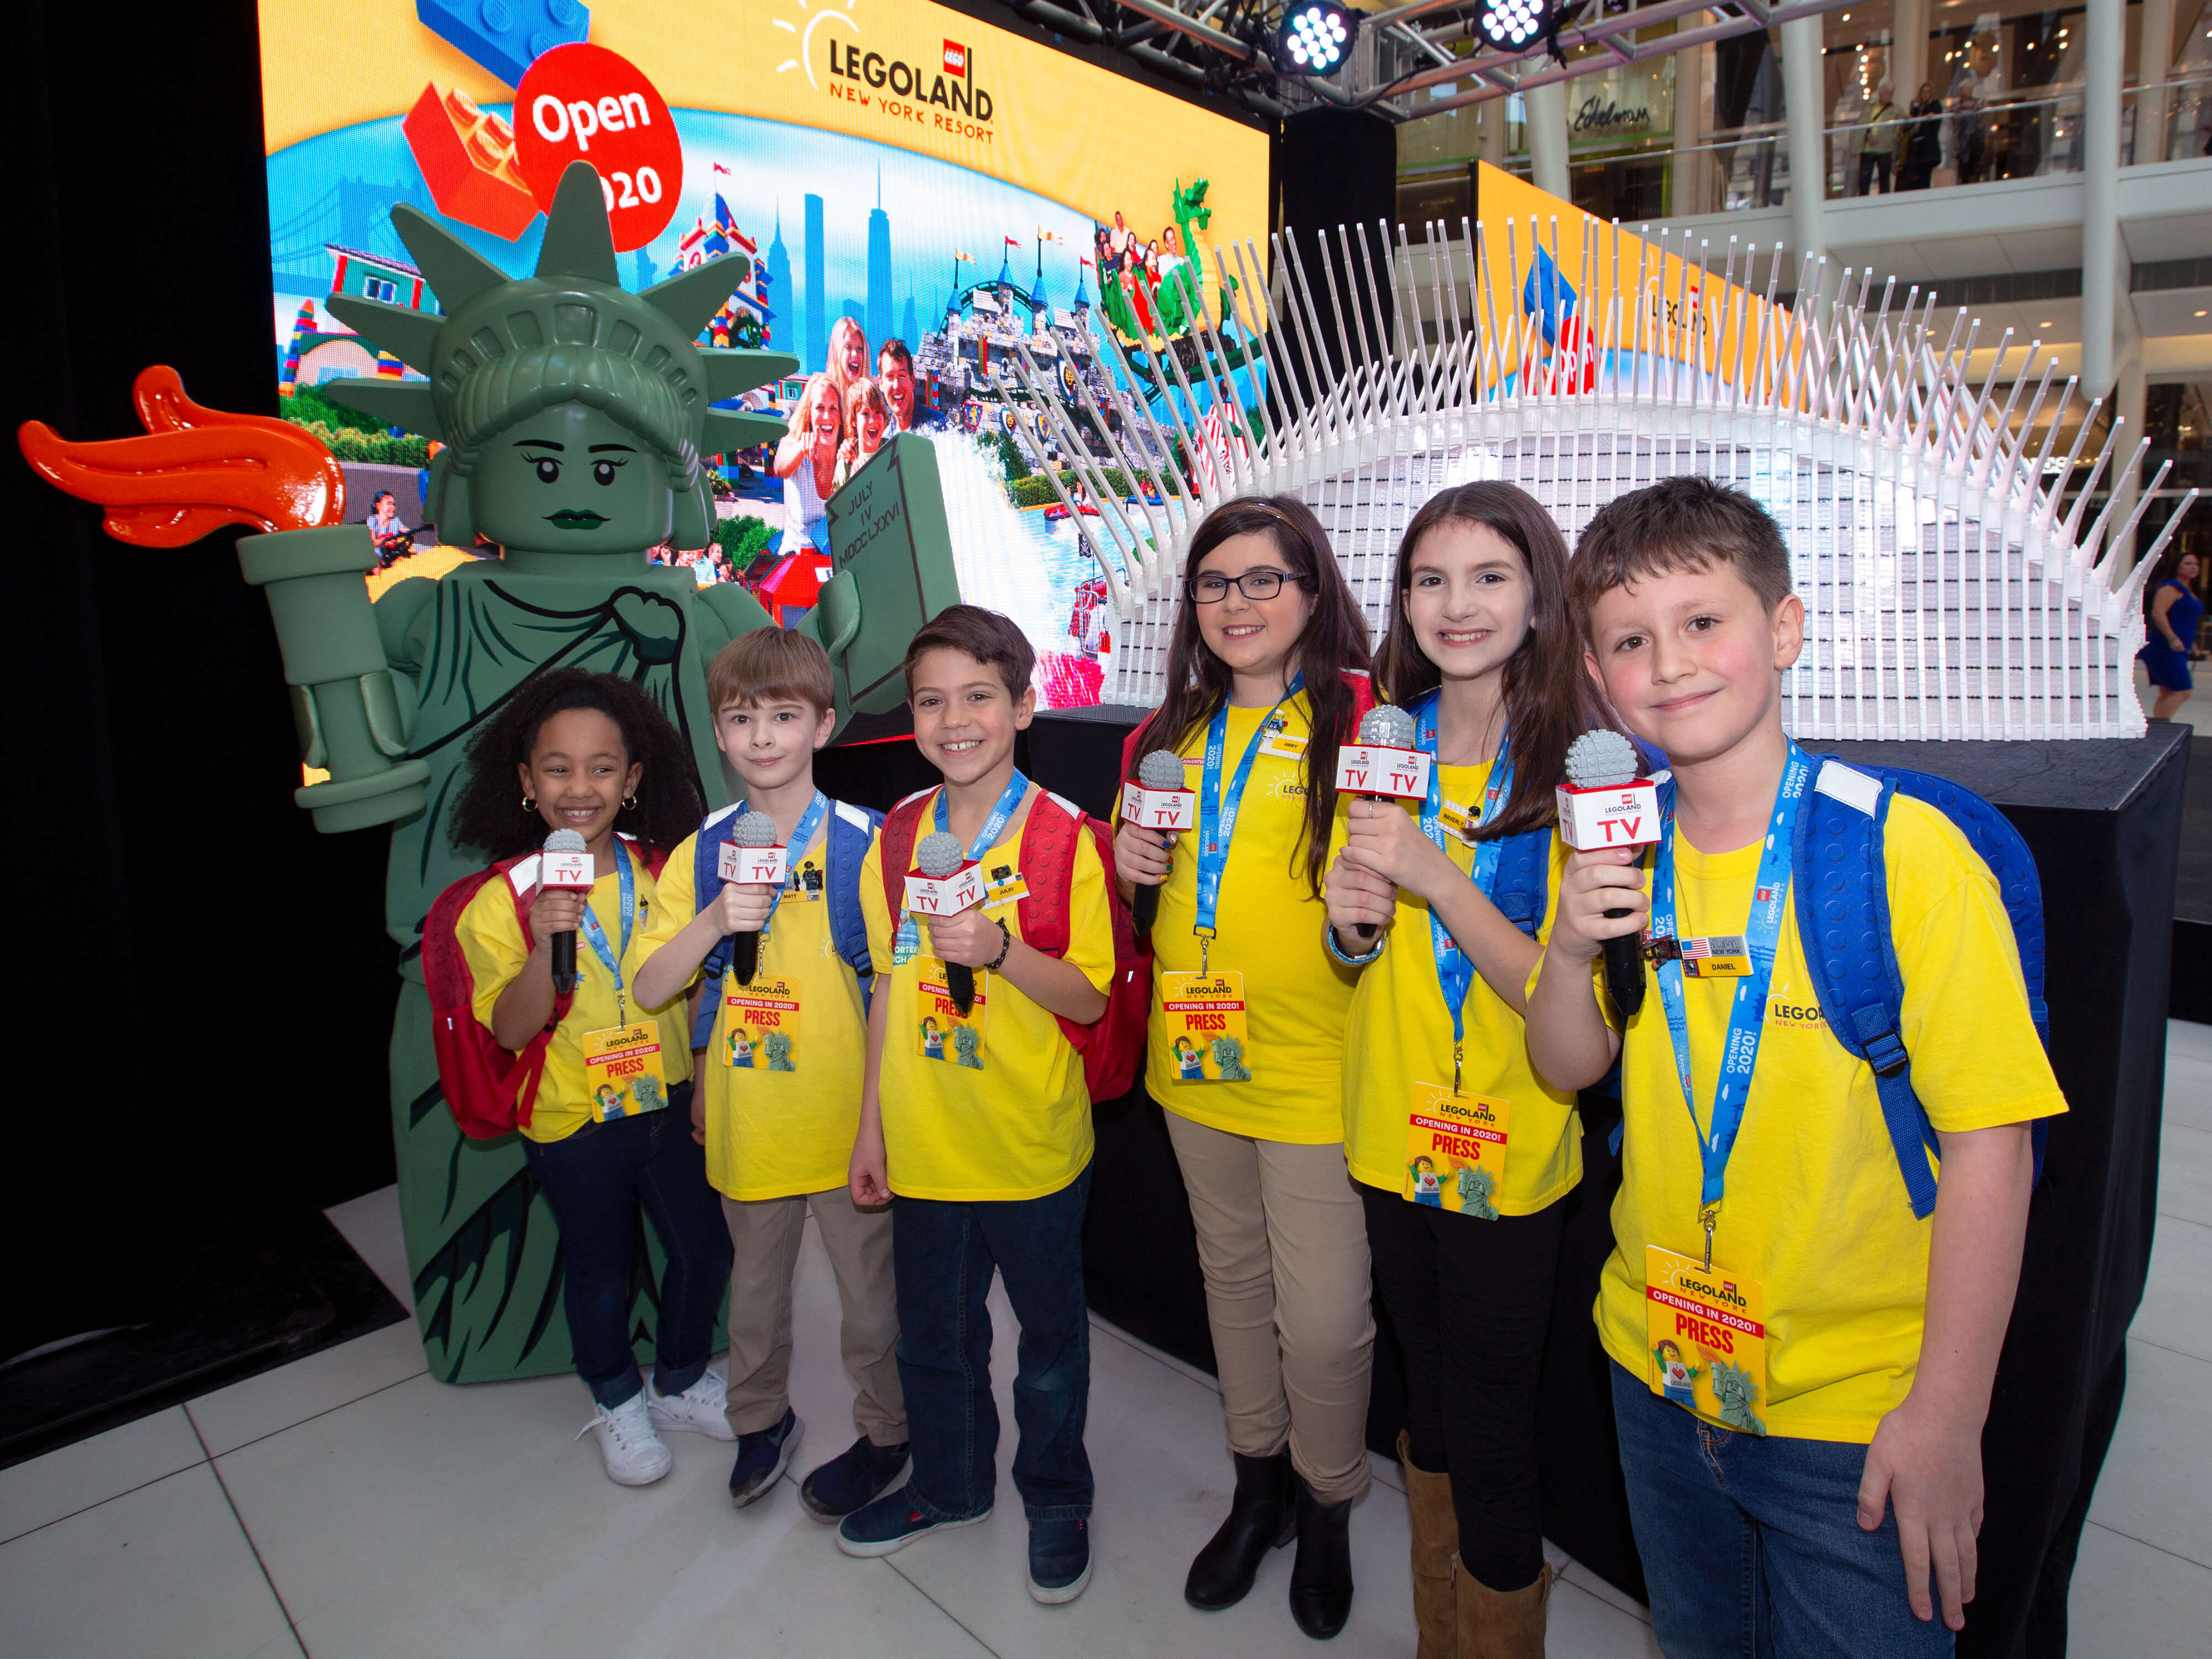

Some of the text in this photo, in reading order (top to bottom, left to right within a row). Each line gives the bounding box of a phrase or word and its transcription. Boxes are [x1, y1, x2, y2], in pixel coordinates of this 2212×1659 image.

[944, 49, 964, 67] LEGO
[830, 39, 993, 121] LEGOLAND
[533, 92, 651, 152] Open
[830, 81, 993, 144] NEW YORK RESORT
[848, 481, 873, 516] JULY
[861, 504, 872, 526] IV
[839, 502, 900, 568] MDCCLXXVI
[1207, 745, 1216, 770] 2020!
[1397, 757, 1420, 770] LEGOLAND
[1345, 769, 1368, 788] TV
[1390, 773, 1417, 793] TV
[1782, 761, 1799, 798] OPENING
[1128, 803, 1141, 821] TV
[1605, 792, 1641, 813] LEGOLAND
[982, 811, 1000, 838] OPENING
[988, 814, 1007, 840] 2020!
[1155, 810, 1181, 826] TV
[1218, 806, 1230, 836] OPENING
[1223, 807, 1237, 837] 2020!
[1443, 813, 1464, 827] WAVERLY
[1597, 817, 1642, 842] TV
[758, 852, 778, 863] LEGOLAND
[555, 870, 582, 882] TV
[724, 862, 737, 878] TV
[752, 867, 776, 880] TV
[916, 896, 938, 911] TV
[956, 885, 975, 906] TV
[1759, 882, 1780, 924] LEGOLAND
[749, 982, 790, 995] LEGOLAND
[1186, 979, 1232, 994] LEGOLAND
[731, 998, 763, 1007] OPENING
[744, 1009, 780, 1026] PRESS
[1186, 1014, 1226, 1030] PRESS
[606, 1029, 648, 1047] LEGOLAND
[589, 1053, 624, 1065] OPENING
[635, 1045, 655, 1055] 2020!
[1726, 1028, 1742, 1073] OPENING
[1737, 1031, 1757, 1074] 2020!
[606, 1058, 644, 1078] PRESS
[1441, 1104, 1495, 1121] LEGOLAND
[1468, 1118, 1495, 1128] YORK
[1416, 1117, 1501, 1141] OPENING IN 2020!
[1432, 1133, 1480, 1160] PRESS
[1680, 1277, 1746, 1307] LEGOLAND
[1680, 1287, 1747, 1314] NEW YORK
[1653, 1290, 1756, 1333] OPENING IN 2020!
[1676, 1312, 1734, 1354] PRESS
